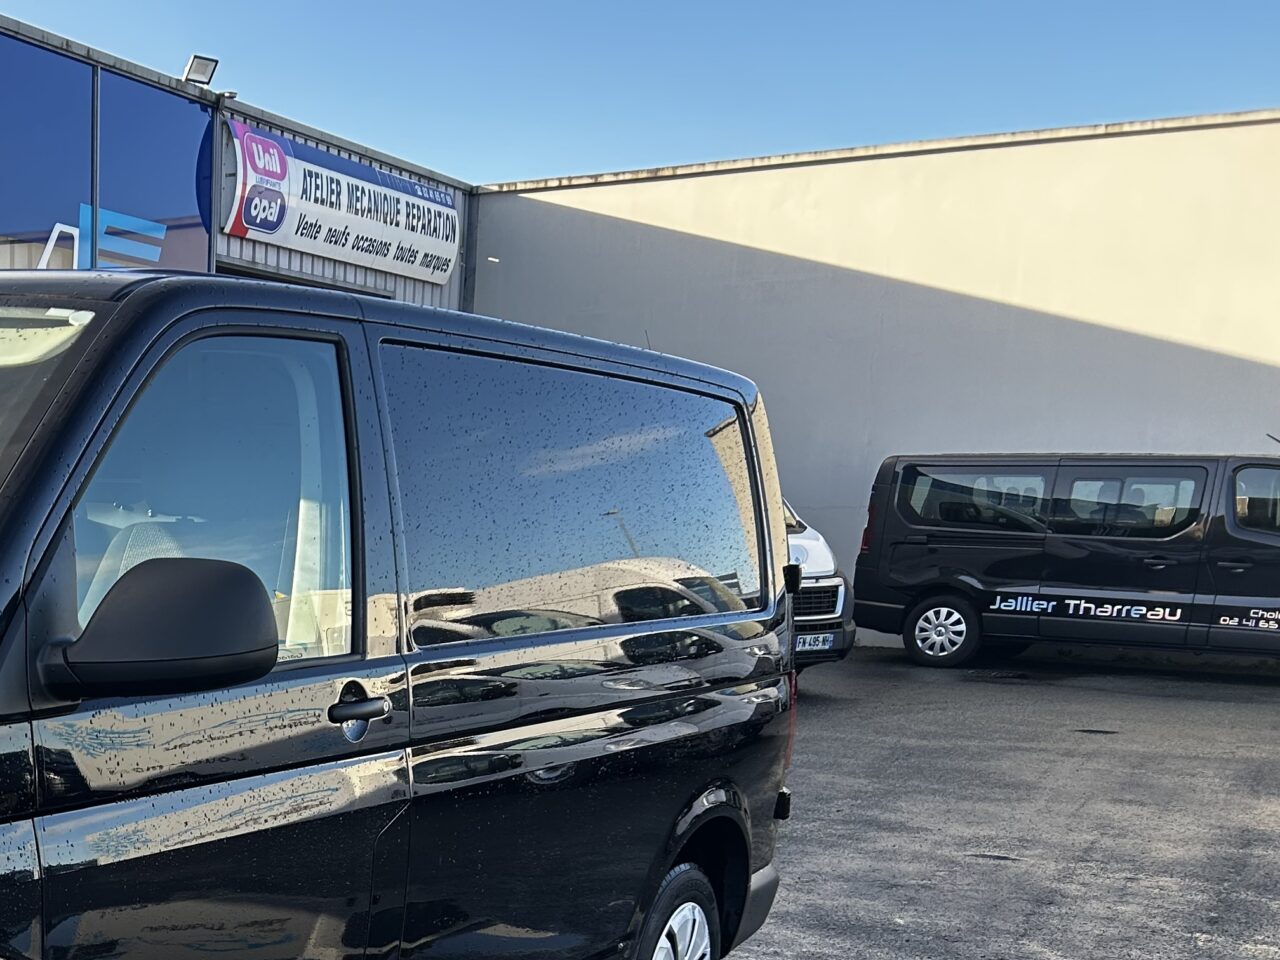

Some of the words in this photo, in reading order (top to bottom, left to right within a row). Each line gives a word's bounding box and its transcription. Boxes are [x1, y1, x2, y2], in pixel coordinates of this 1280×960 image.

[251, 142, 281, 173] Unil
[250, 197, 281, 224] opal
[300, 167, 342, 212] ATELIER
[346, 182, 401, 228] MECANIQUE
[404, 200, 456, 244] REPARATION
[294, 212, 322, 241] Vente
[323, 224, 350, 248] neufs
[351, 233, 392, 258] occasions
[392, 240, 419, 265] toutes
[419, 252, 451, 275] marques
[990, 596, 1057, 613] Jallier
[1065, 600, 1182, 621] Tharreau
[1250, 609, 1280, 619] Chol
[1220, 617, 1239, 625] 02
[1258, 619, 1279, 629] 65
